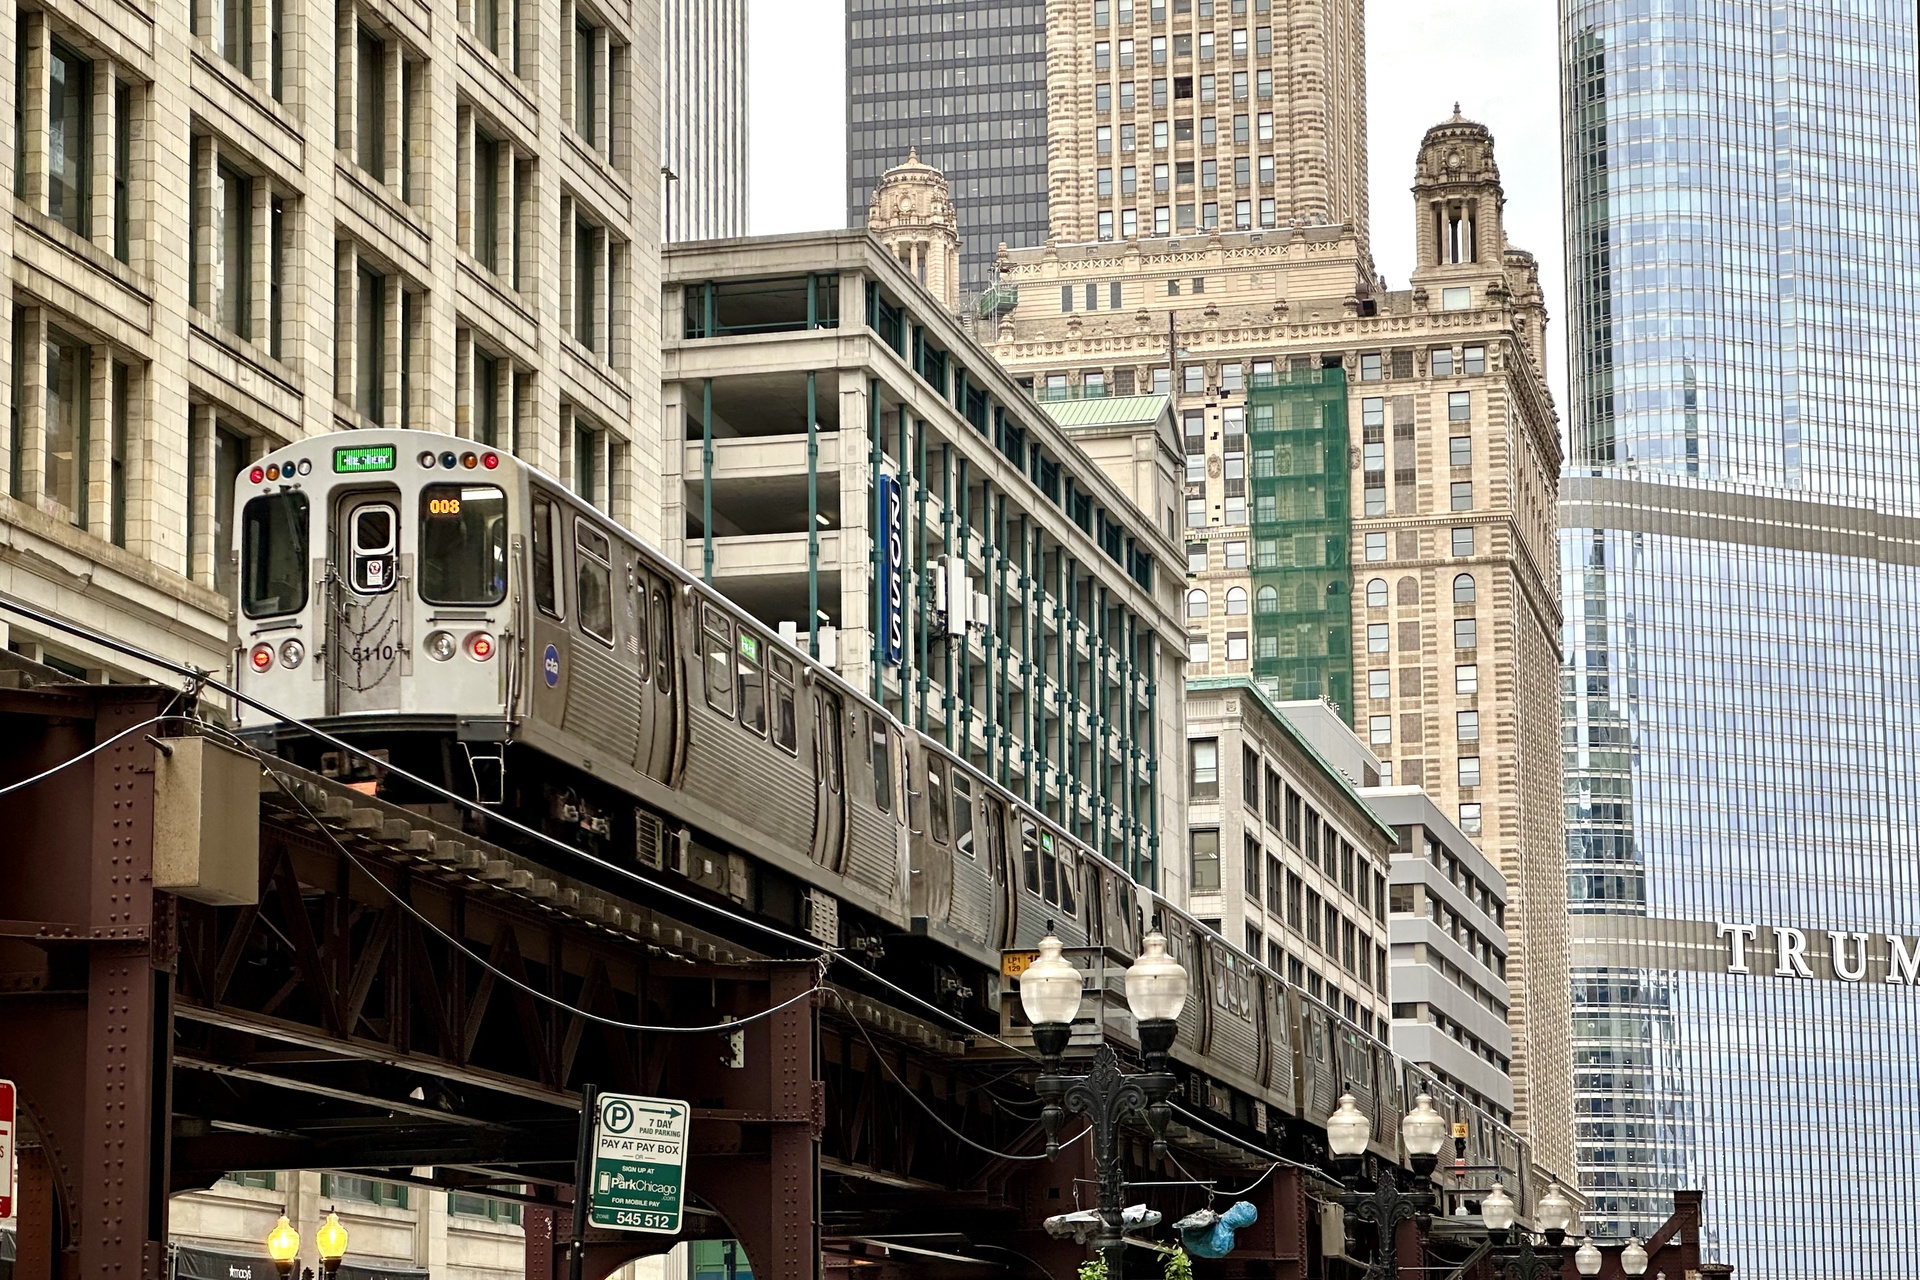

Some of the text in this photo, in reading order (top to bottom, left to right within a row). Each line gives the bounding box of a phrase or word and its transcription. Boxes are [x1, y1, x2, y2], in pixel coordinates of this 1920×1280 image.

[430, 499, 460, 514] 008
[891, 491, 901, 649] ROSS
[352, 645, 393, 661] 5110
[545, 658, 558, 674] cta
[649, 1119, 673, 1128] 7 DAY
[655, 1129, 681, 1138] PARKING
[601, 1139, 679, 1155] PAY AT PAY BOX
[611, 1177, 677, 1195] ParkChicago
[625, 1198, 648, 1206] MOBILE
[616, 1212, 641, 1225] 545
[644, 1214, 669, 1228] 512
